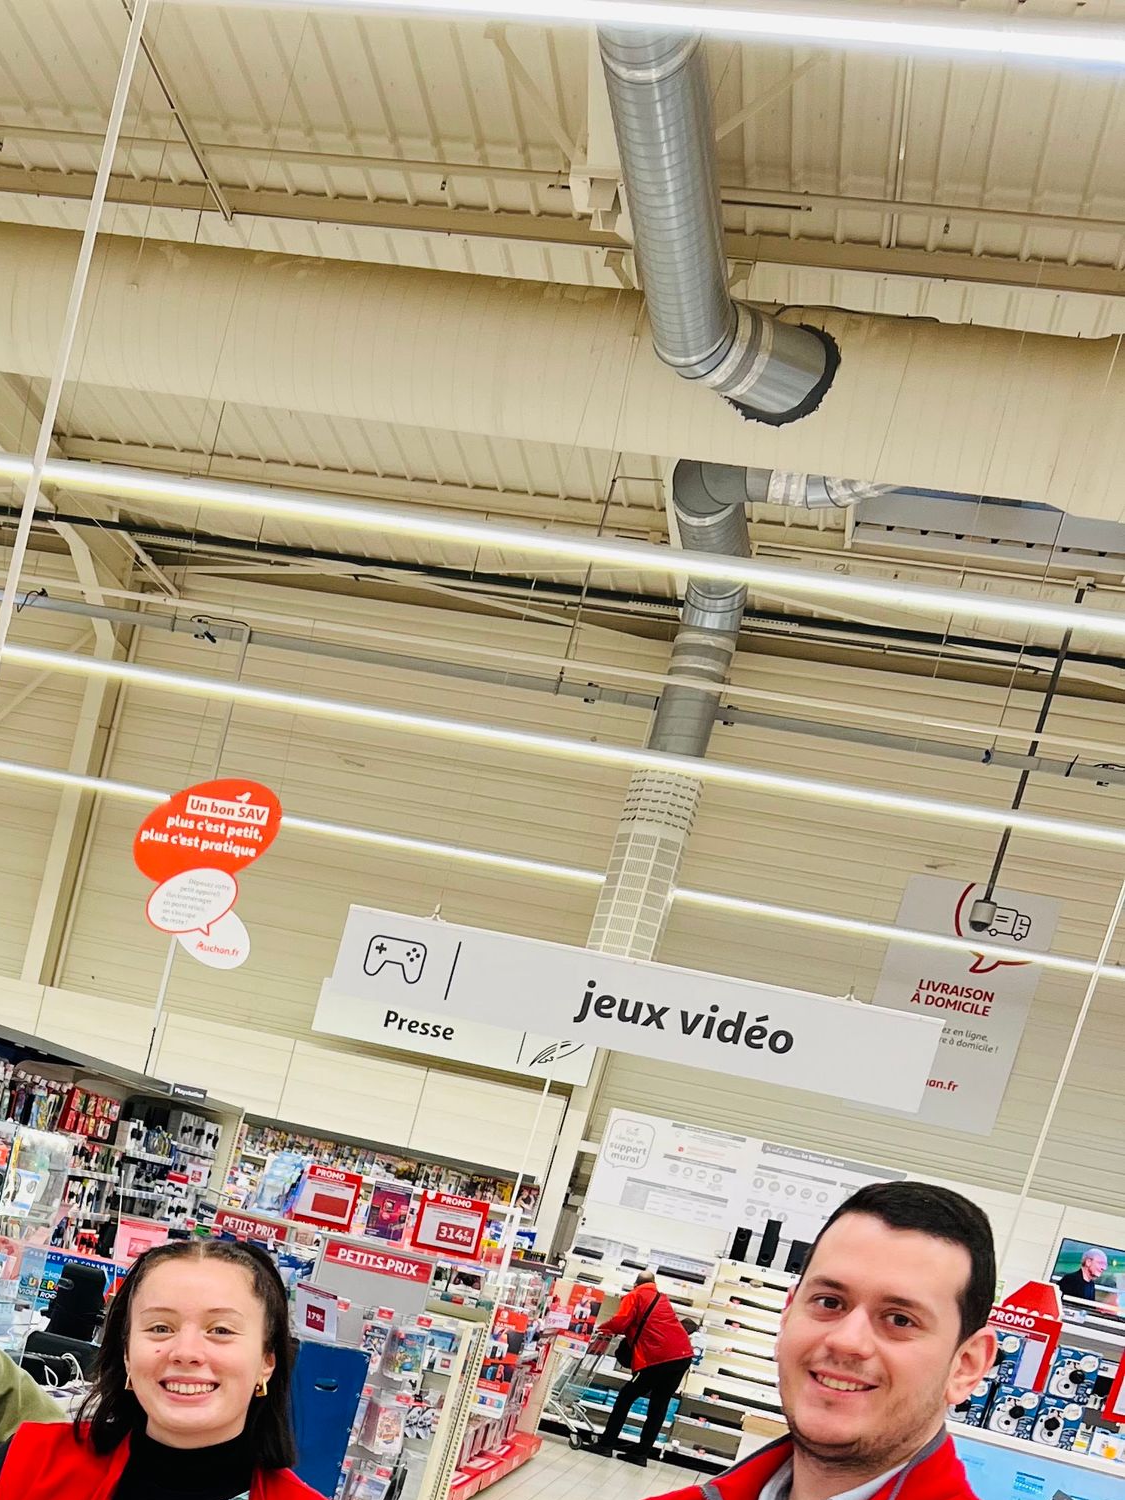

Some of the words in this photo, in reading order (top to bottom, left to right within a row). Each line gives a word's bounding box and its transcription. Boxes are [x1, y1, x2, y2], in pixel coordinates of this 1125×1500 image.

[190, 799, 207, 812] Un
[210, 802, 235, 816] bon
[238, 807, 266, 821] SAV
[166, 814, 195, 829] plus
[196, 819, 226, 834] c'est
[140, 828, 169, 843] plus
[170, 833, 199, 848] c'est
[200, 839, 256, 858] pratique
[196, 941, 239, 956] Auchan.fr
[918, 979, 995, 1003] LIVRAISON
[910, 989, 921, 1004] À
[924, 995, 992, 1017] DOMICILE
[383, 1009, 455, 1041] Presse
[574, 980, 669, 1029] jeux
[680, 1004, 795, 1056] vidéo
[953, 1029, 964, 1037] en
[956, 1039, 993, 1053] domicile
[926, 1079, 959, 1092] an.fr
[610, 1142, 647, 1155] support
[611, 1152, 640, 1163] mural
[316, 1168, 346, 1181] PROMO
[441, 1196, 472, 1208] PROMO
[223, 1216, 255, 1232] PETITS
[255, 1223, 278, 1238] PRIX
[338, 1248, 384, 1269] PETITS
[386, 1258, 419, 1276] PRIX
[988, 1309, 1035, 1328] PROMO
